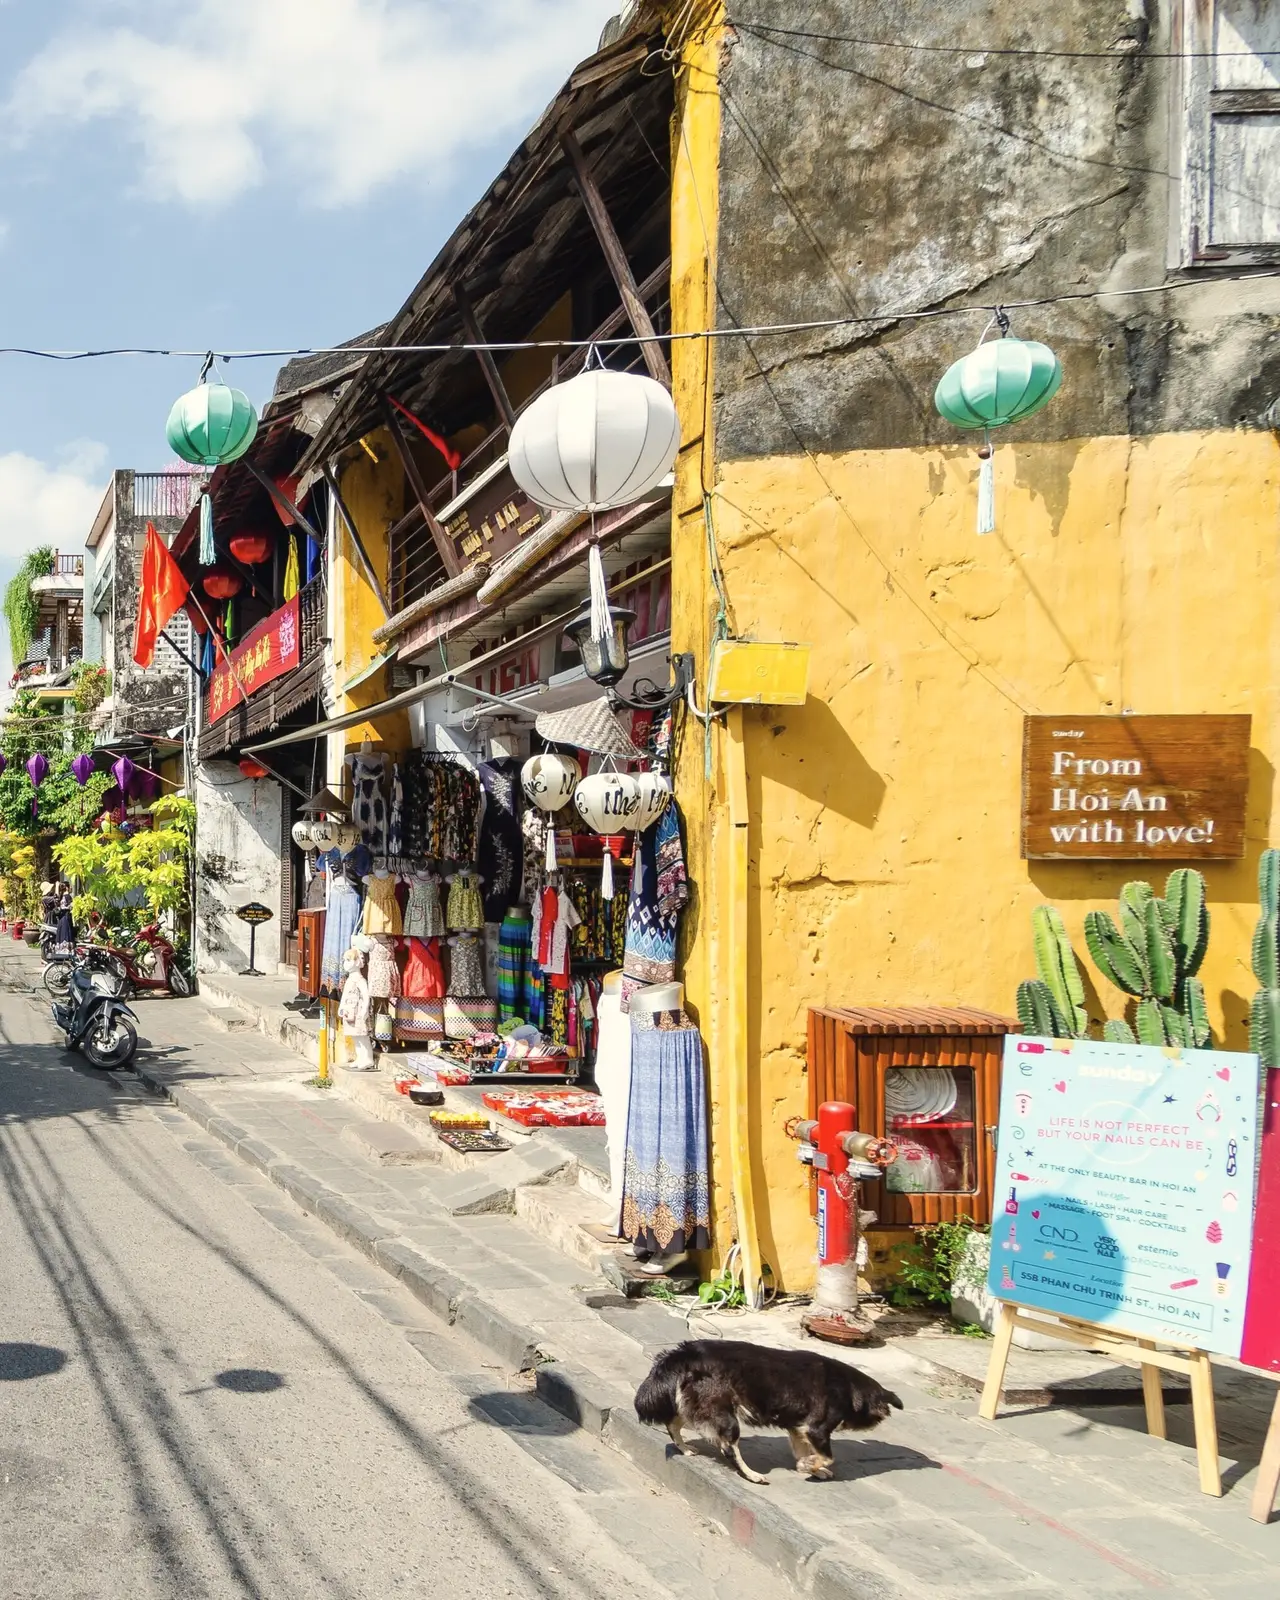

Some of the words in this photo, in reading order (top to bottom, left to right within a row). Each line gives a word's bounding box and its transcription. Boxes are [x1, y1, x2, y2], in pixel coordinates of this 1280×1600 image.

[1051, 751, 1142, 776] From
[1050, 788, 1111, 811] Hoi
[1119, 787, 1168, 812] An
[1050, 818, 1124, 843] with
[1135, 819, 1214, 844] love!
[1078, 1064, 1162, 1086] sunday
[1049, 1116, 1075, 1128] LIFE
[1079, 1119, 1090, 1128] IS
[1094, 1120, 1123, 1131] NOT
[1127, 1122, 1190, 1136] PERFECT
[1037, 1129, 1061, 1138] BUT
[1065, 1130, 1101, 1142] YOUR
[1105, 1134, 1145, 1146] NAILS
[1149, 1137, 1180, 1149] CAN
[1186, 1140, 1204, 1151] BE
[1050, 1164, 1066, 1173] THE
[1068, 1167, 1091, 1177] ONLY
[1093, 1170, 1127, 1182] BEAUTY
[1129, 1177, 1148, 1186] BAR
[1149, 1180, 1160, 1188] IN
[1162, 1182, 1180, 1191] HOI
[1182, 1185, 1197, 1194] AN
[1048, 1202, 1086, 1215] MASSAGE
[1091, 1208, 1115, 1219] FOOT
[1116, 1214, 1131, 1223] SPA
[1138, 1218, 1187, 1234] COCKTAILS
[1065, 1196, 1088, 1206] NAILS
[1095, 1201, 1116, 1211] LASH
[1122, 1206, 1144, 1216] HAIR
[1145, 1210, 1168, 1221] CARE
[1039, 1224, 1079, 1243] CND
[1137, 1243, 1179, 1258] estemio
[1041, 1275, 1071, 1290] PHAN
[1072, 1283, 1097, 1296] CHU
[1099, 1289, 1133, 1304] TRINH
[1158, 1303, 1179, 1315] HOI
[1183, 1309, 1200, 1320] AN
